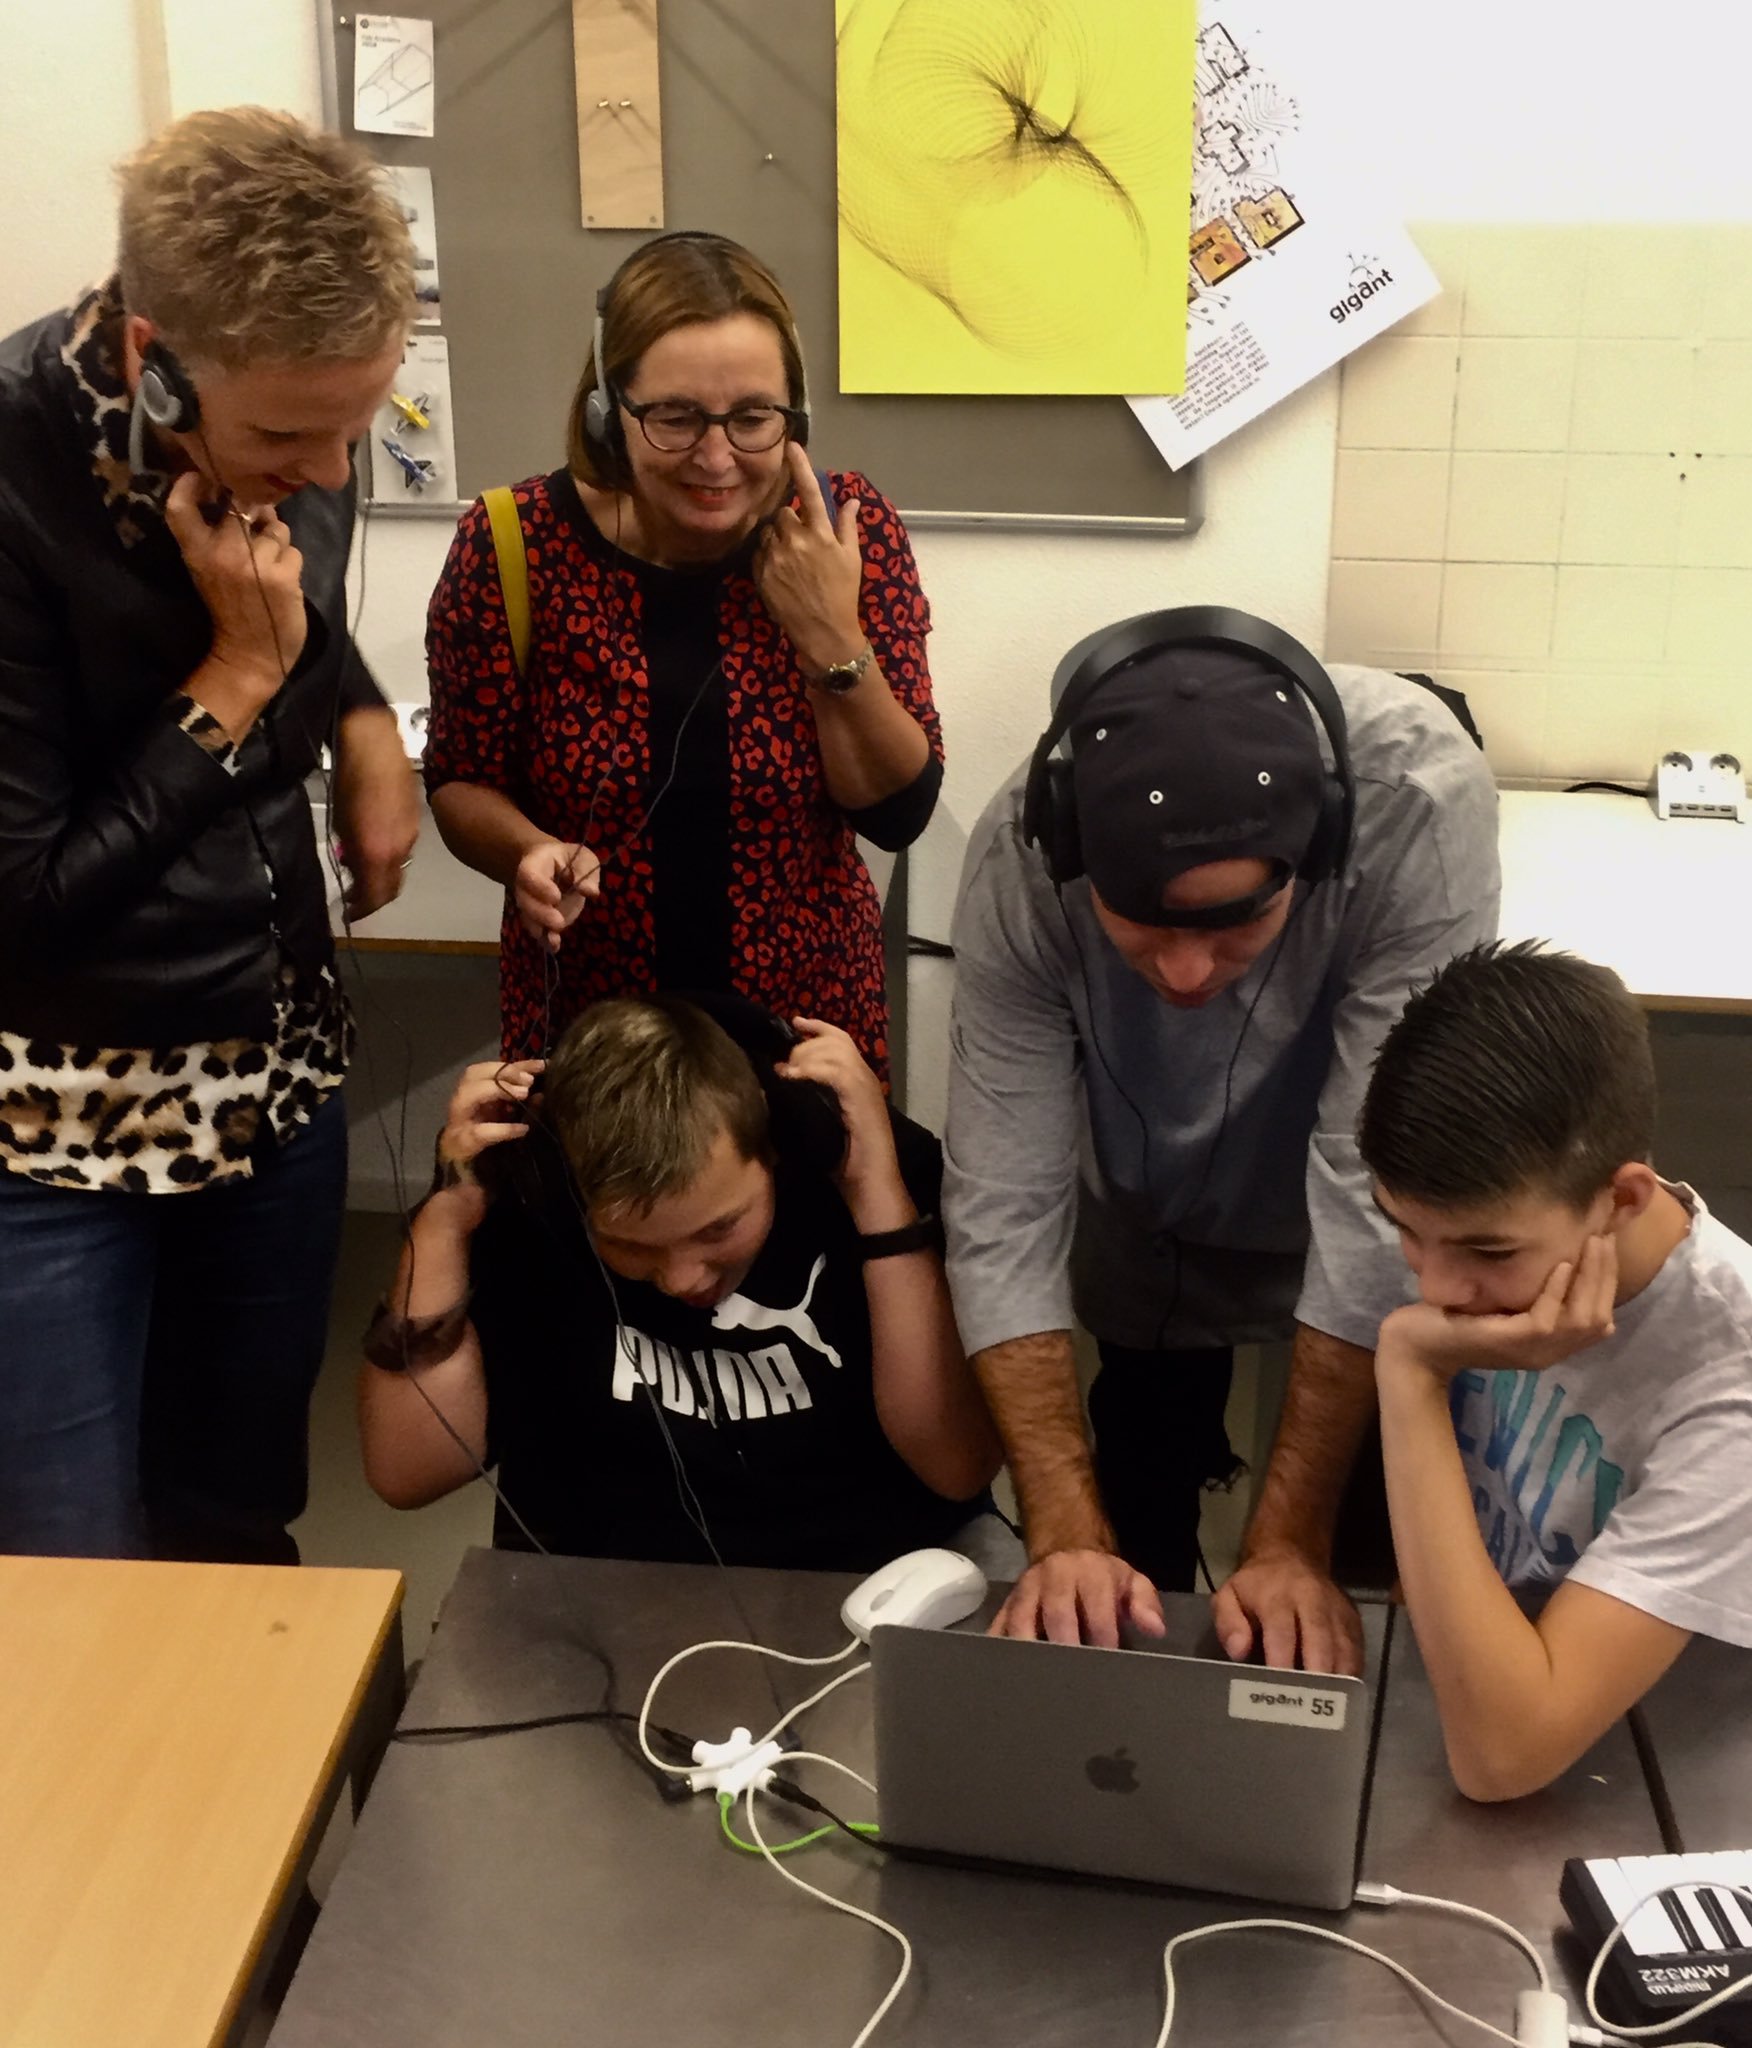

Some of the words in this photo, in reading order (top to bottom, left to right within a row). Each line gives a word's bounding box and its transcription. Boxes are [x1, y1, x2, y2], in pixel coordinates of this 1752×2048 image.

[1329, 268, 1394, 324] gigant
[612, 1324, 813, 1428] PUMA
[1249, 1692, 1304, 1707] gigant
[1311, 1697, 1335, 1717] 55
[1638, 1964, 1730, 1983] AKM322
